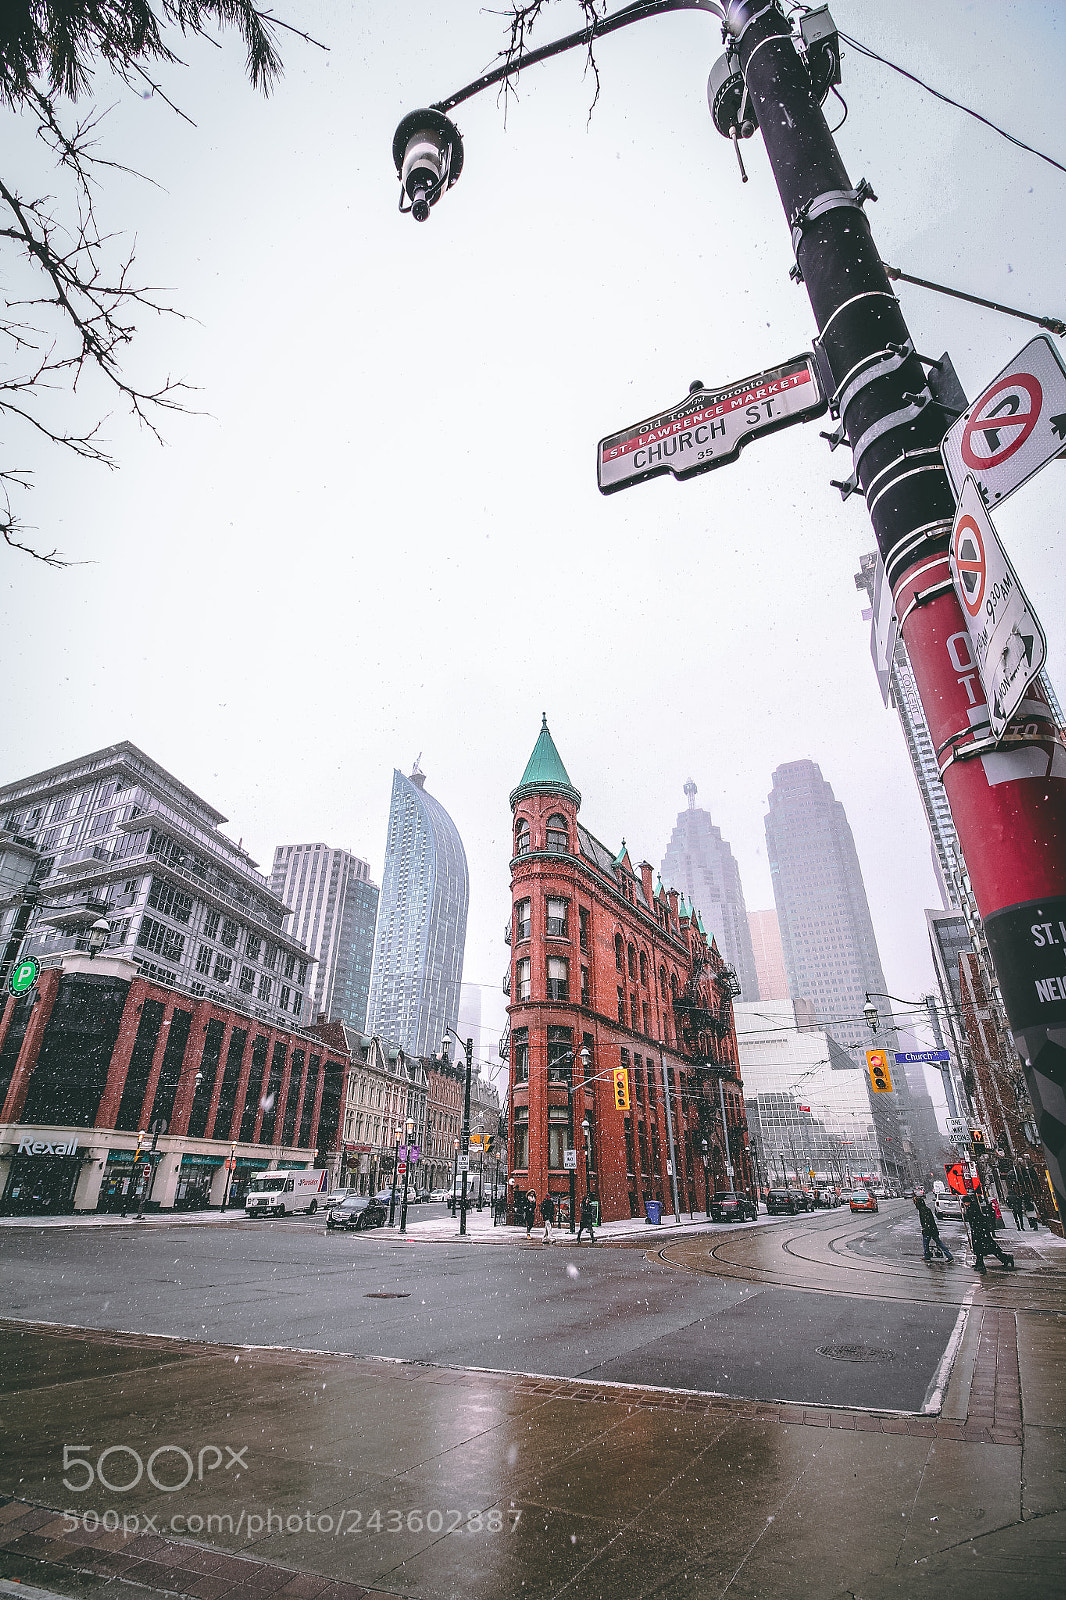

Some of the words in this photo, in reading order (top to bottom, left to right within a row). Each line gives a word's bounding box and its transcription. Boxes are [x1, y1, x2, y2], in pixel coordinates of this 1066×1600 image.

[609, 444, 632, 458] ST.
[638, 405, 724, 446] LAWRENCE
[730, 375, 801, 409] MARKET
[639, 420, 662, 434] Old
[668, 404, 705, 422] Town
[710, 379, 764, 404] Toronto
[633, 418, 726, 469] CHURCH
[745, 398, 781, 425] ST.
[697, 447, 714, 460] 35
[1030, 922, 1060, 947] ST.
[905, 1052, 933, 1061] Church
[17, 1135, 79, 1156] Rexall
